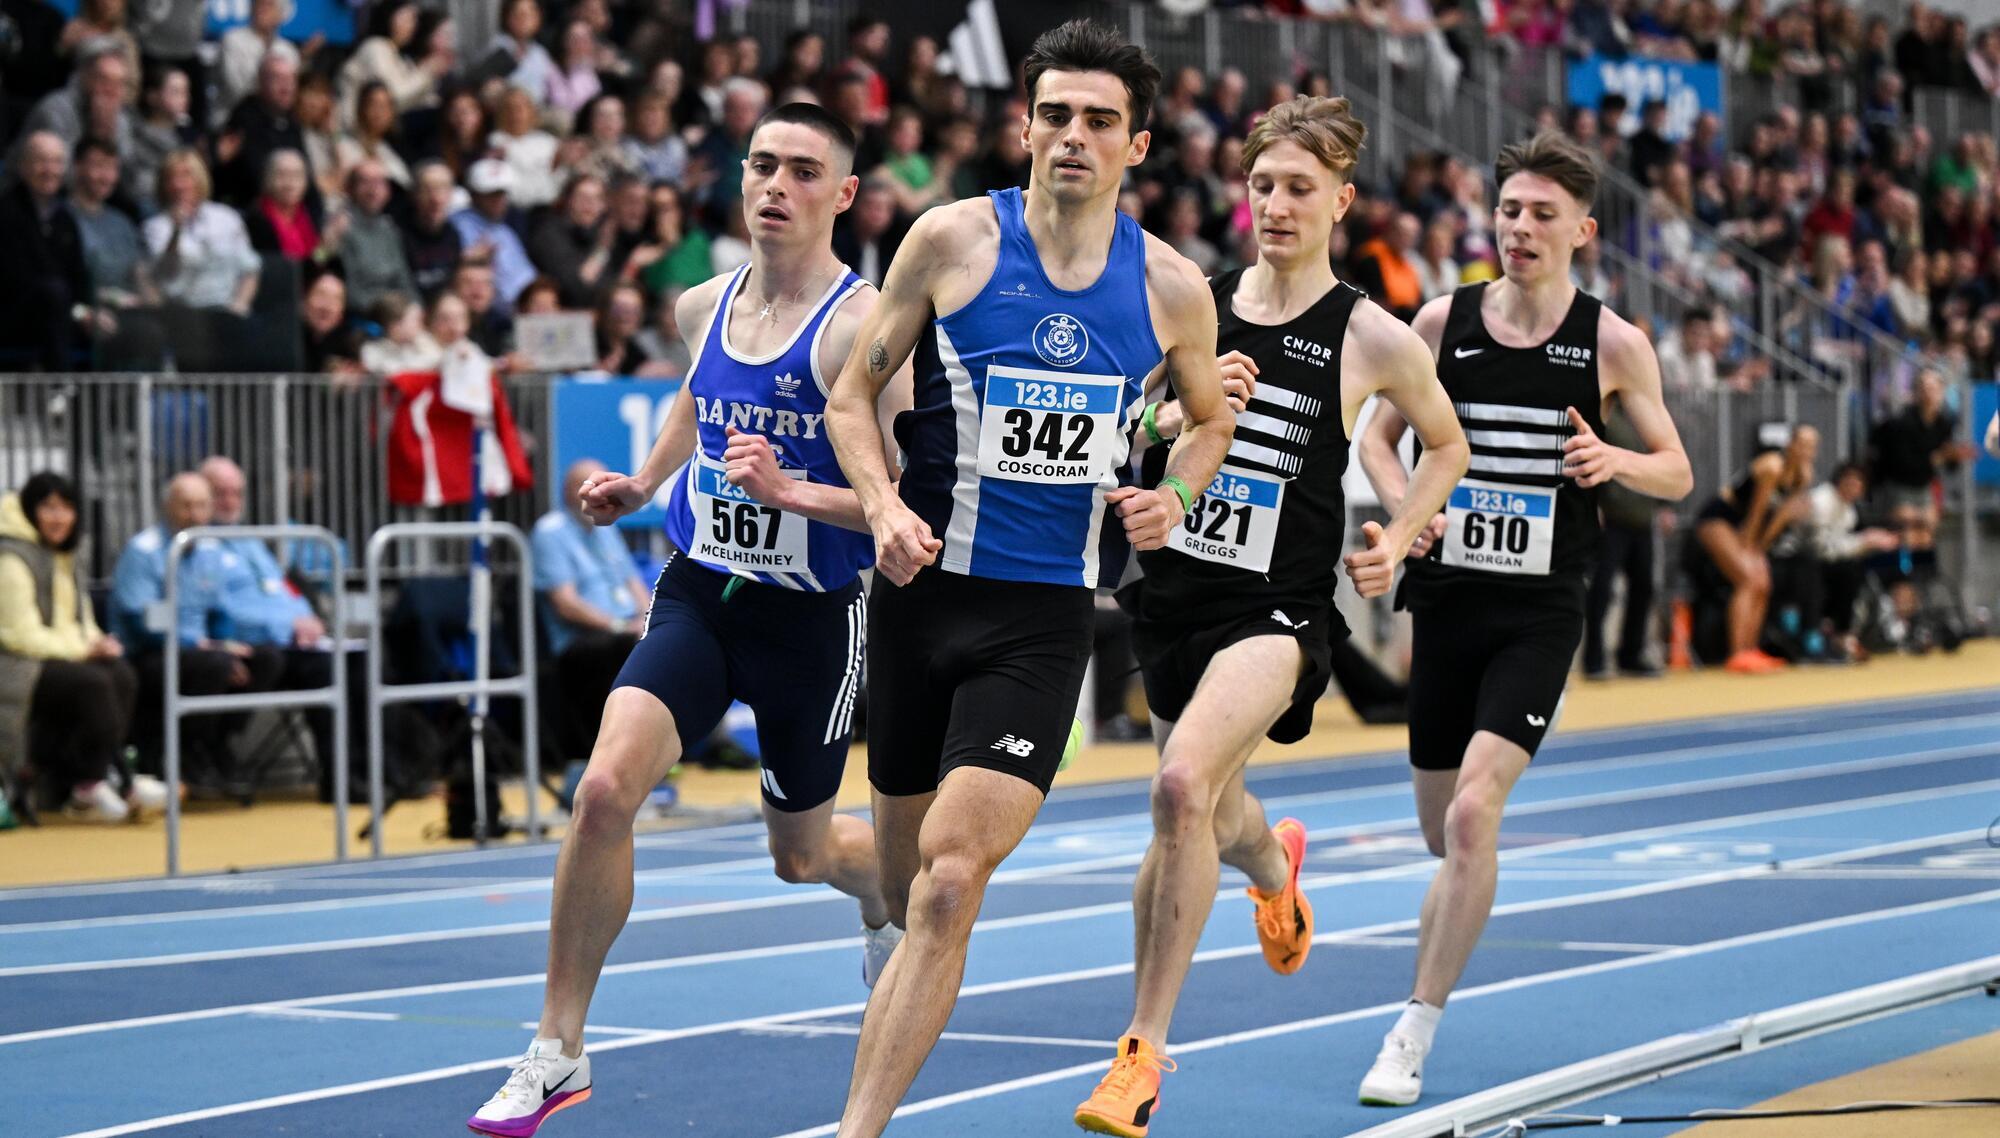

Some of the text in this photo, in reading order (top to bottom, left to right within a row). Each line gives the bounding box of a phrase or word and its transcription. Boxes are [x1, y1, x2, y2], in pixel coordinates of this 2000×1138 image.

[1283, 335, 1332, 360] CN/DR
[1284, 350, 1325, 367] TRACK CLUB
[1546, 343, 1591, 361] CN/DR
[775, 390, 797, 399] adidas
[1015, 382, 1088, 410] 123.ie
[695, 397, 825, 440] BANTRY
[1002, 408, 1095, 461] 342
[997, 460, 1089, 477] COSCORAN
[1470, 489, 1527, 515] 123.ie
[712, 497, 782, 549] 567
[1184, 492, 1253, 546] 321
[1463, 512, 1530, 554] 610
[700, 543, 794, 566] MCELHINNEY
[1184, 537, 1238, 559] GRIGGS
[1464, 552, 1523, 567] MORGAN
